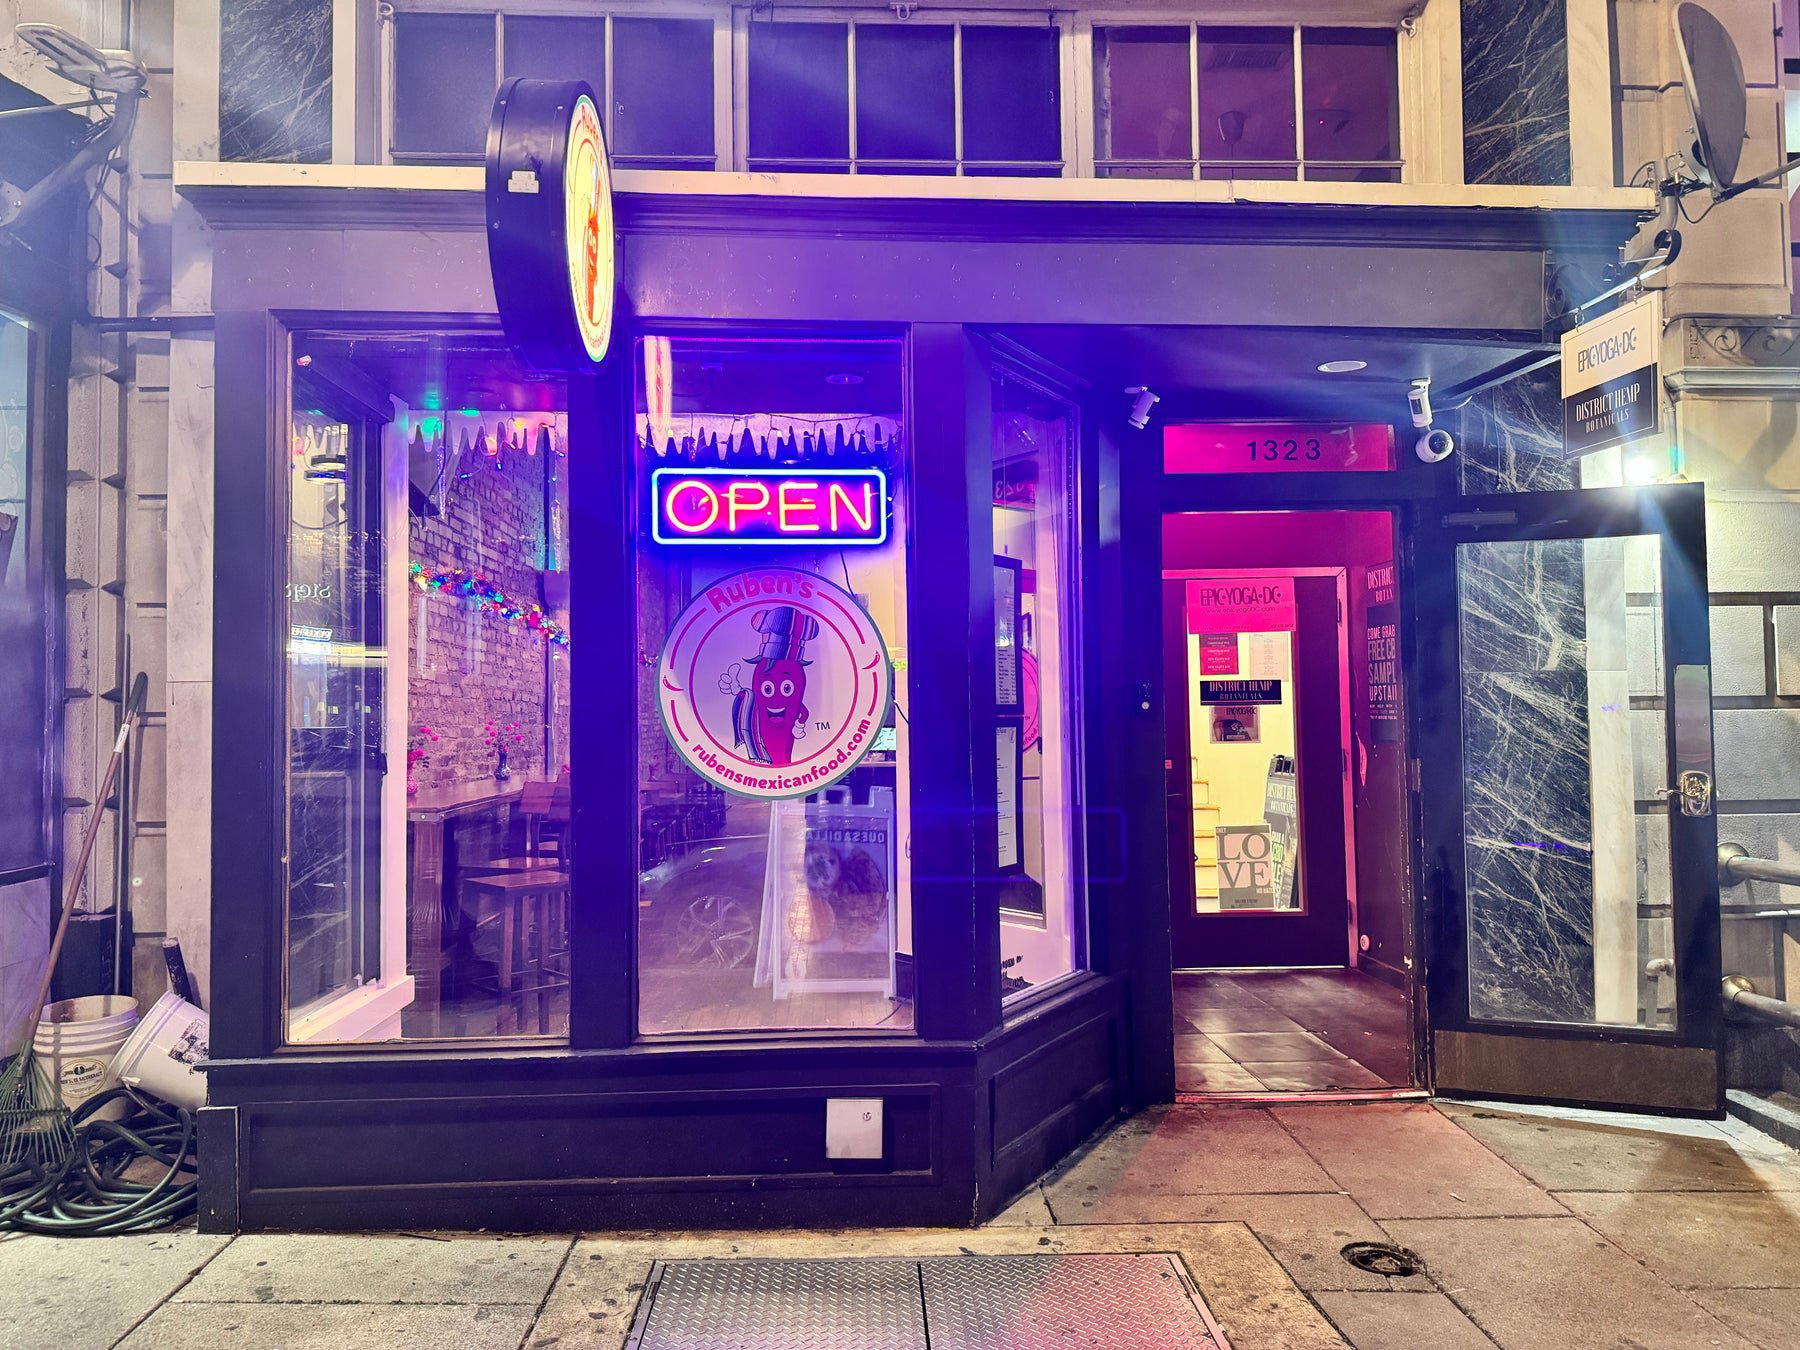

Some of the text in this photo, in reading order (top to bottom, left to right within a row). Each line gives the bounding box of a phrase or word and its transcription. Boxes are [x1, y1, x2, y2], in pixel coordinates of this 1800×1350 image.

[1576, 382, 1640, 422] DISTRICT HEMP
[1585, 408, 1629, 433] BOTANICALS
[1247, 438, 1321, 462] 1323
[666, 480, 872, 532] OPEN
[705, 572, 815, 615] Ruben's
[1367, 624, 1396, 640] COME GRAB
[1368, 640, 1385, 661] FREE
[1209, 681, 1246, 692] DISTRICT
[815, 722, 831, 731] TM
[692, 718, 871, 790] rubensmexicanfood.com
